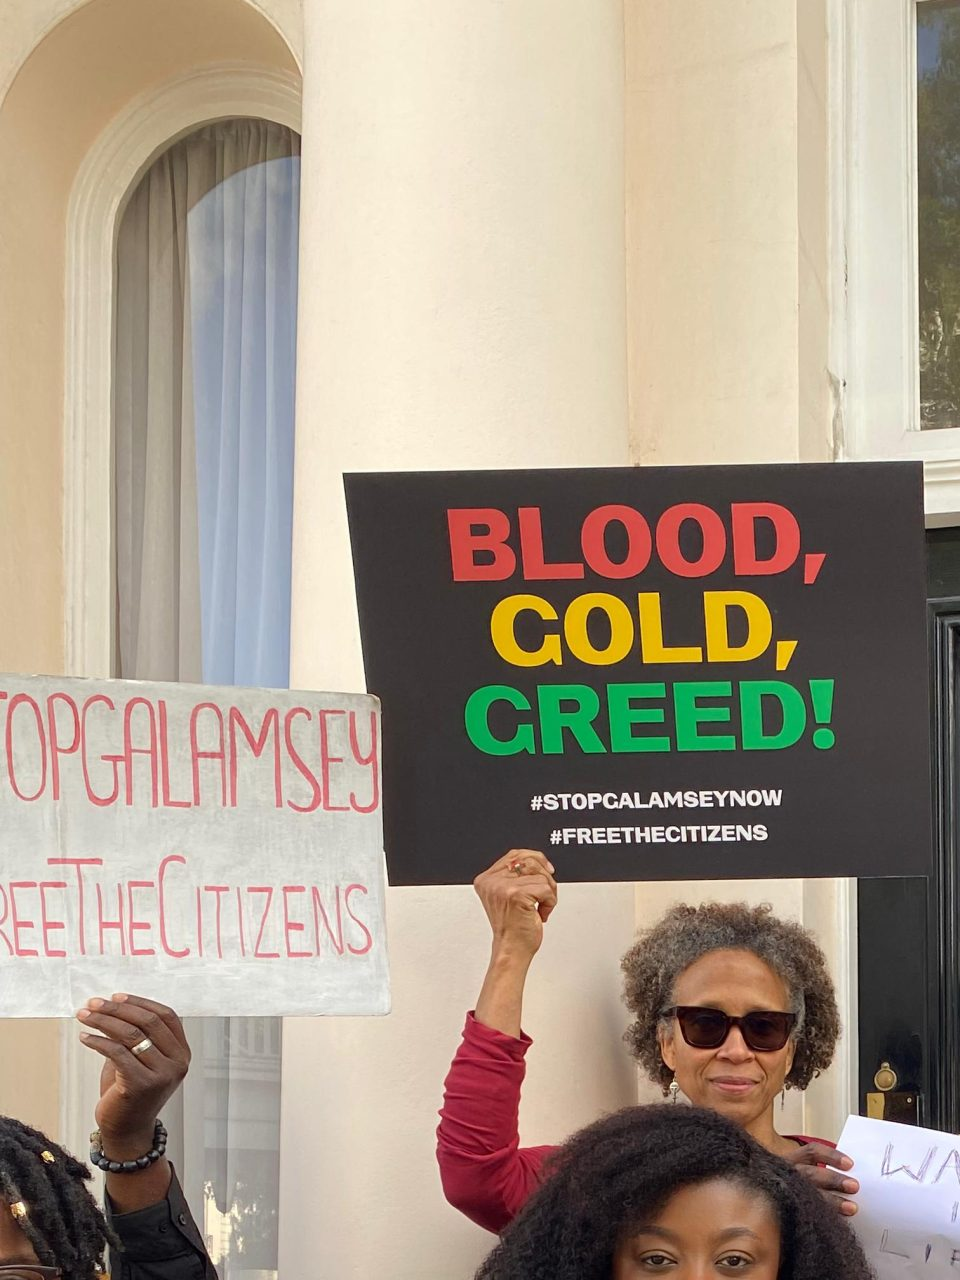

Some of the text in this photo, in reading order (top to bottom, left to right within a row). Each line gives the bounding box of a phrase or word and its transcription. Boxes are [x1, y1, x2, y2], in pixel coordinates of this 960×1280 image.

[446, 502, 826, 585] BLOOD,
[490, 591, 799, 671] GOLD,
[0, 690, 379, 813] OPGALAMSEY
[464, 679, 836, 756] GREED!
[530, 789, 783, 811] #STOPGALAMSEYNOW
[550, 824, 769, 846] #FREETHECITIZENS
